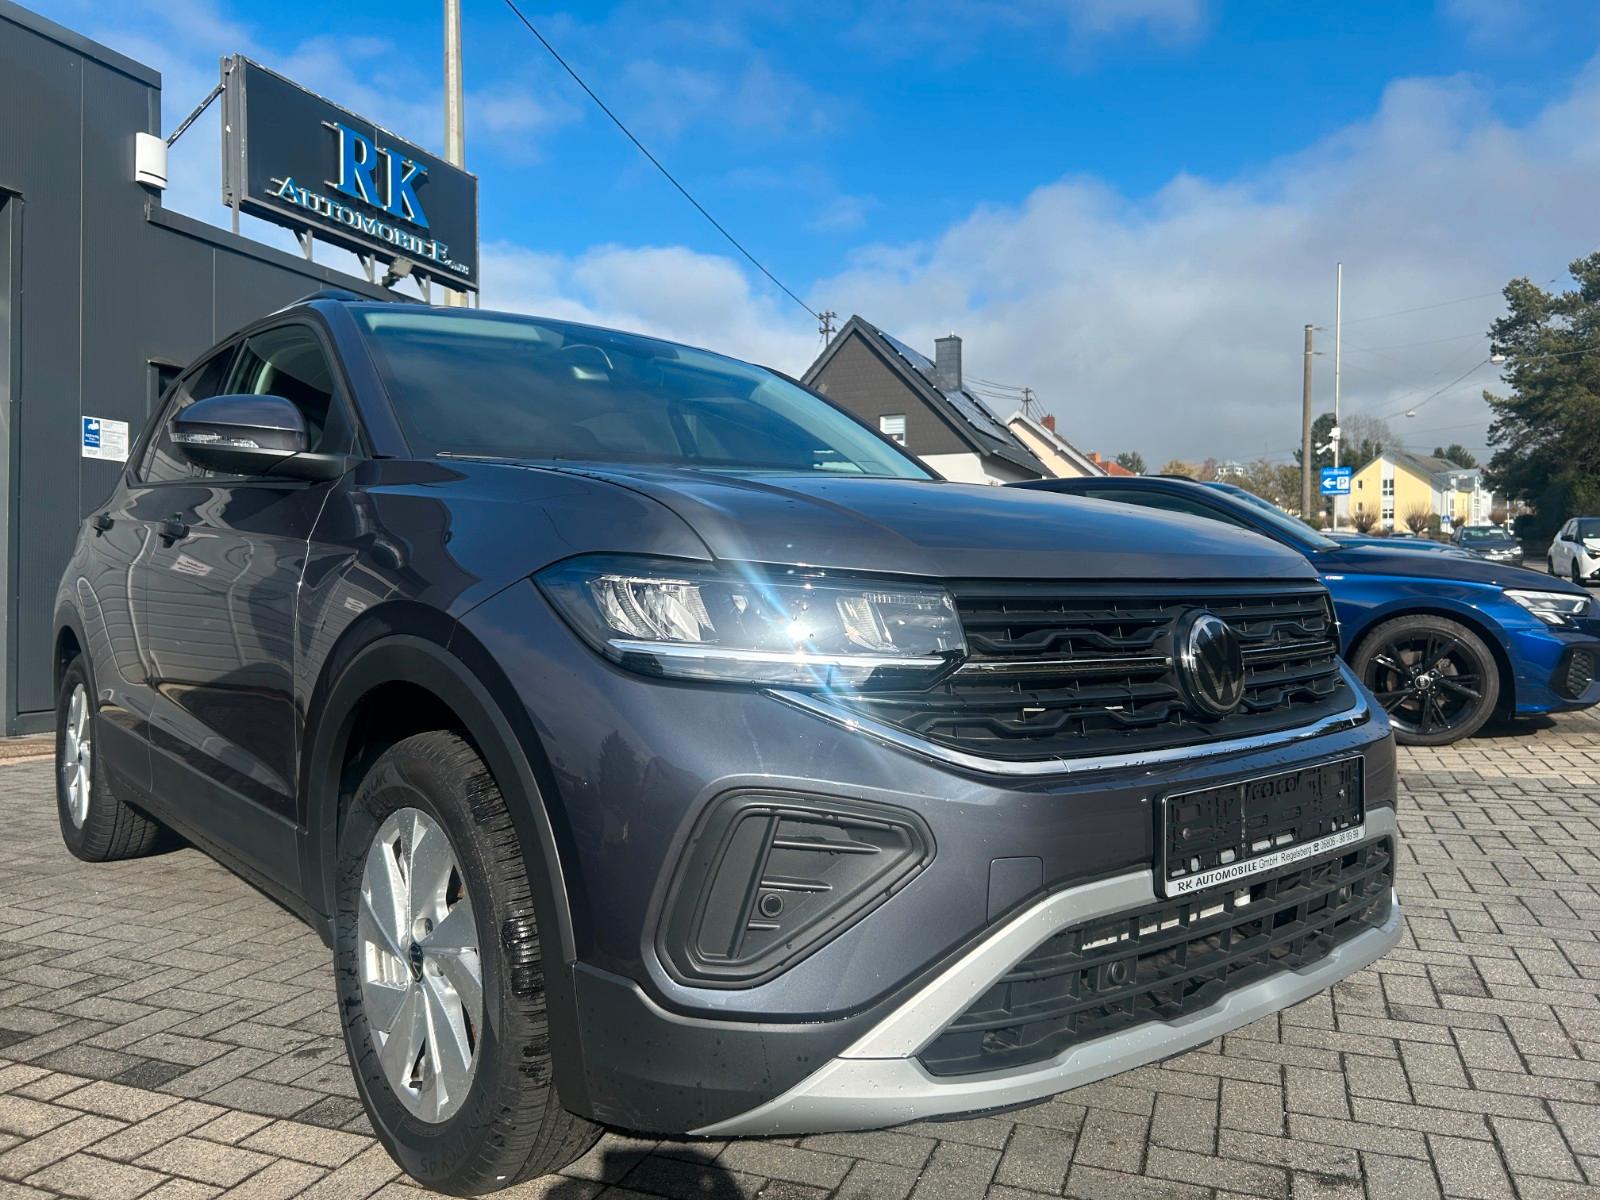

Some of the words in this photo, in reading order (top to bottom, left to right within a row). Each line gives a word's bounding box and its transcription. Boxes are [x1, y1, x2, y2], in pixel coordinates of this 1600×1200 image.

[321, 120, 430, 229] RK
[265, 177, 452, 264] AUTOMOBILE
[1178, 880, 1193, 892] RK
[1196, 861, 1257, 887] AUTOMOBILE
[1259, 854, 1278, 868] GmbH
